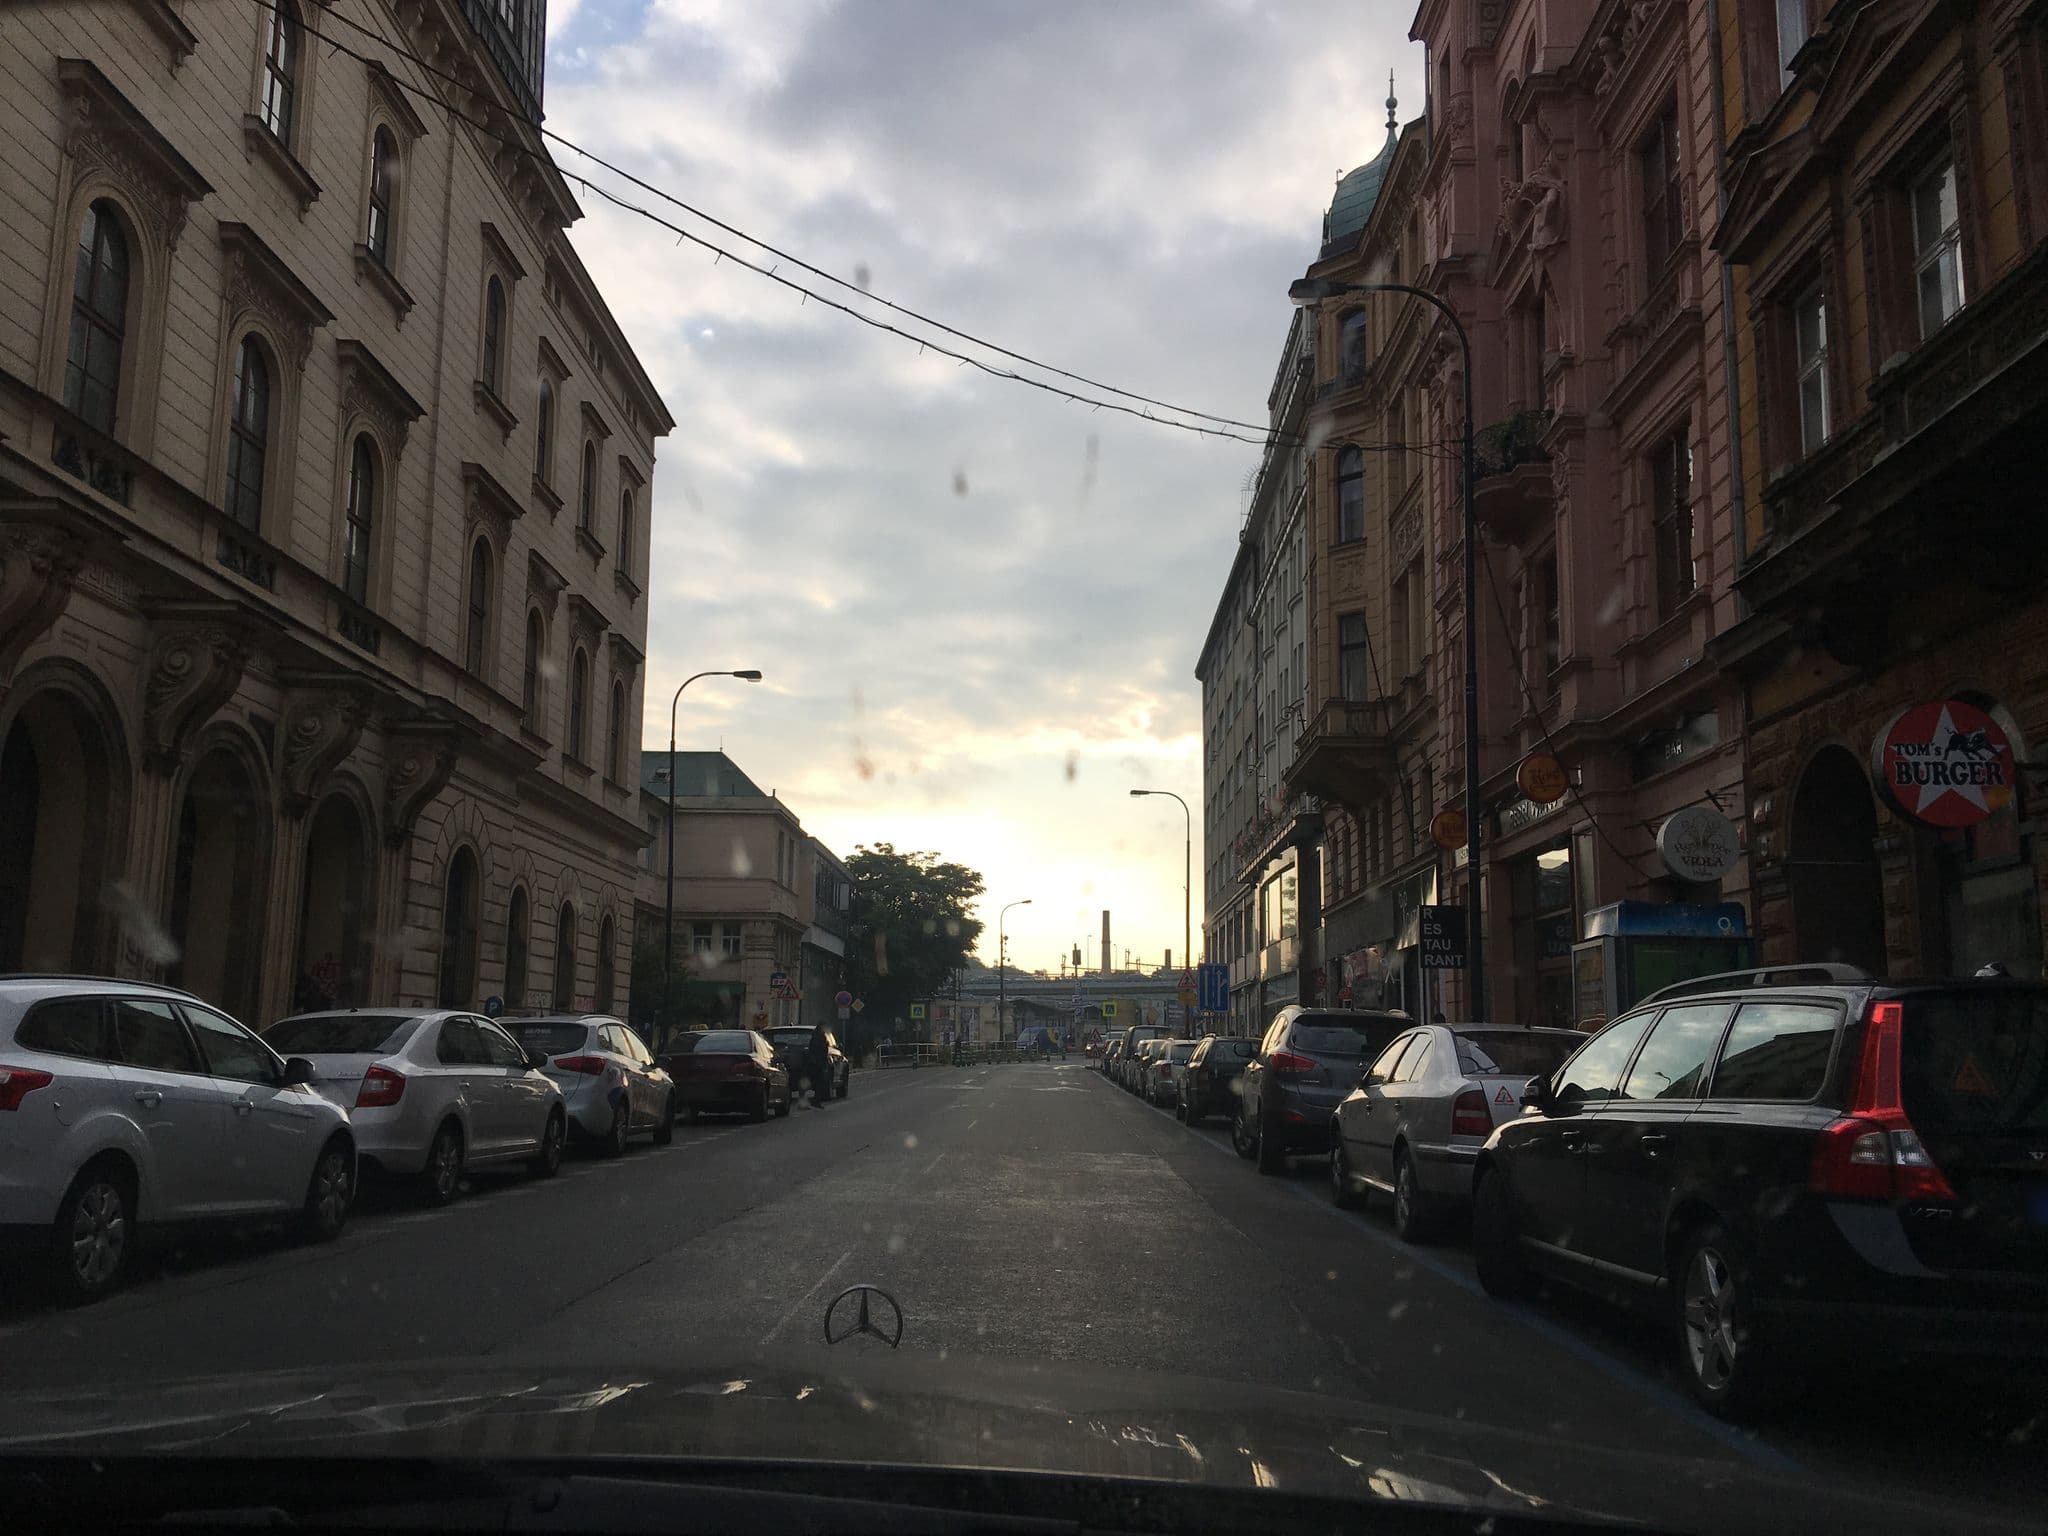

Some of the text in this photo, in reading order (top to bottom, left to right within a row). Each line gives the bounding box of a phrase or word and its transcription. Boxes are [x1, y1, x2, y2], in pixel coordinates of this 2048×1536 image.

[1894, 761, 2005, 785] BURGER
[1681, 856, 1724, 867] VIOLA
[1423, 908, 1433, 920] R
[1423, 923, 1442, 935] ES
[1424, 938, 1452, 951] TAU
[1424, 954, 1464, 967] RANT
